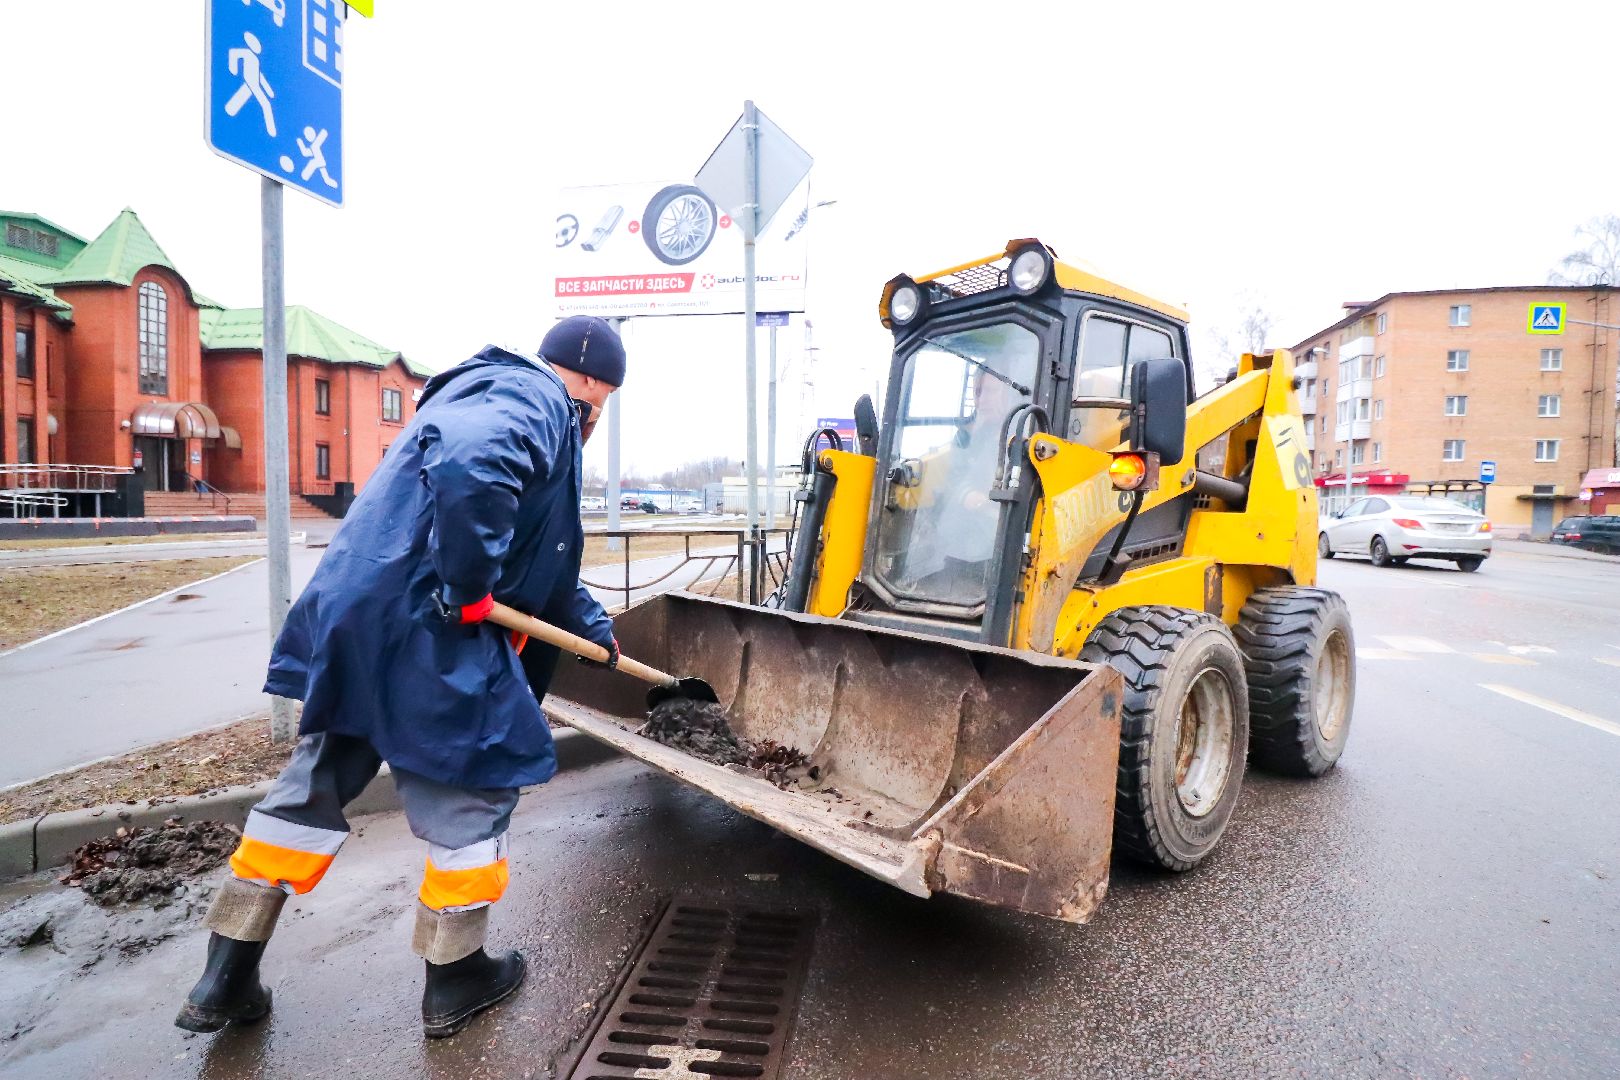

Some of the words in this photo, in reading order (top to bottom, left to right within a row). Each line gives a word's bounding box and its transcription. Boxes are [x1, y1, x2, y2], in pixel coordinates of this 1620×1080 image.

[558, 281, 580, 293] ВСЕ
[582, 278, 644, 292] ЗАПЧАСТИ
[646, 277, 686, 291] ЗДЕСЬ
